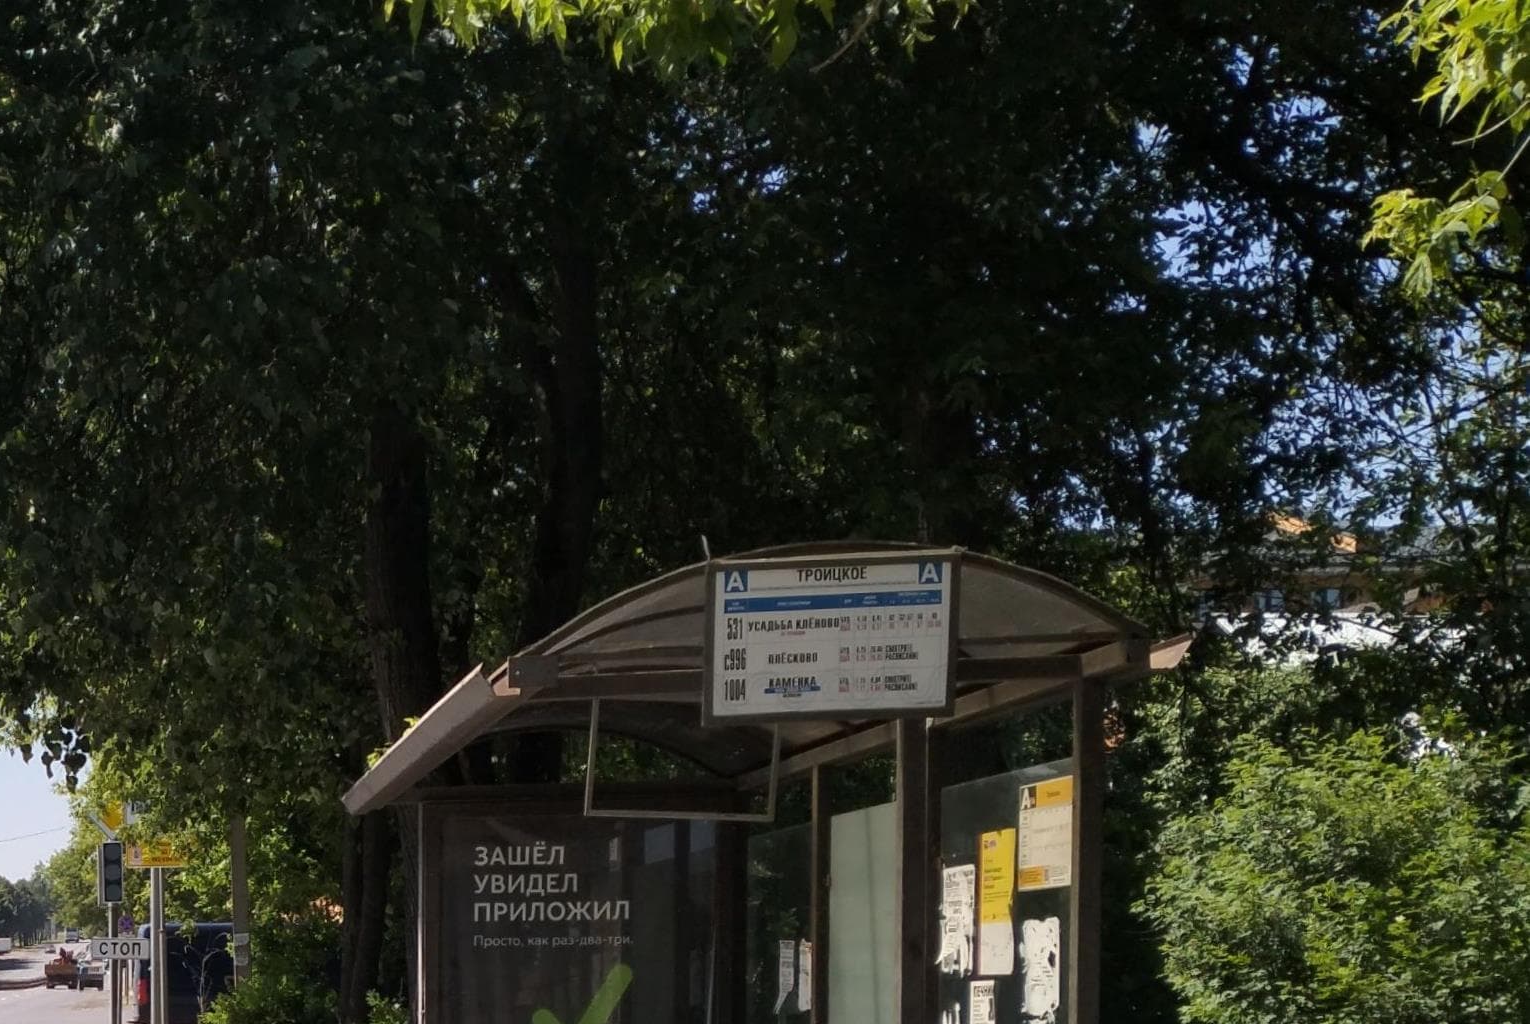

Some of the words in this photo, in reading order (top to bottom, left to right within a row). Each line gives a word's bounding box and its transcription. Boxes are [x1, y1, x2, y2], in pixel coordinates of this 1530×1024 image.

[726, 571, 745, 592] А
[797, 566, 867, 583] ТРОИЦКОЕ
[920, 562, 939, 583] А
[727, 617, 743, 640] 531
[748, 620, 794, 632] УСАДЬБА
[795, 616, 840, 630] КЛЁНОВО
[768, 651, 818, 664] ПЛЁСКОВО
[724, 678, 746, 701] 1004
[769, 676, 817, 689] КАМЕНКА
[474, 841, 565, 866] ЗАШЁЛ
[474, 873, 578, 896] УВИДЕЛ
[474, 900, 630, 922] ПРИЛОЖИЛ
[99, 941, 142, 956] СТОП
[473, 934, 525, 949] Просто,
[527, 937, 549, 946] как
[552, 935, 634, 949] раз-два-три.
